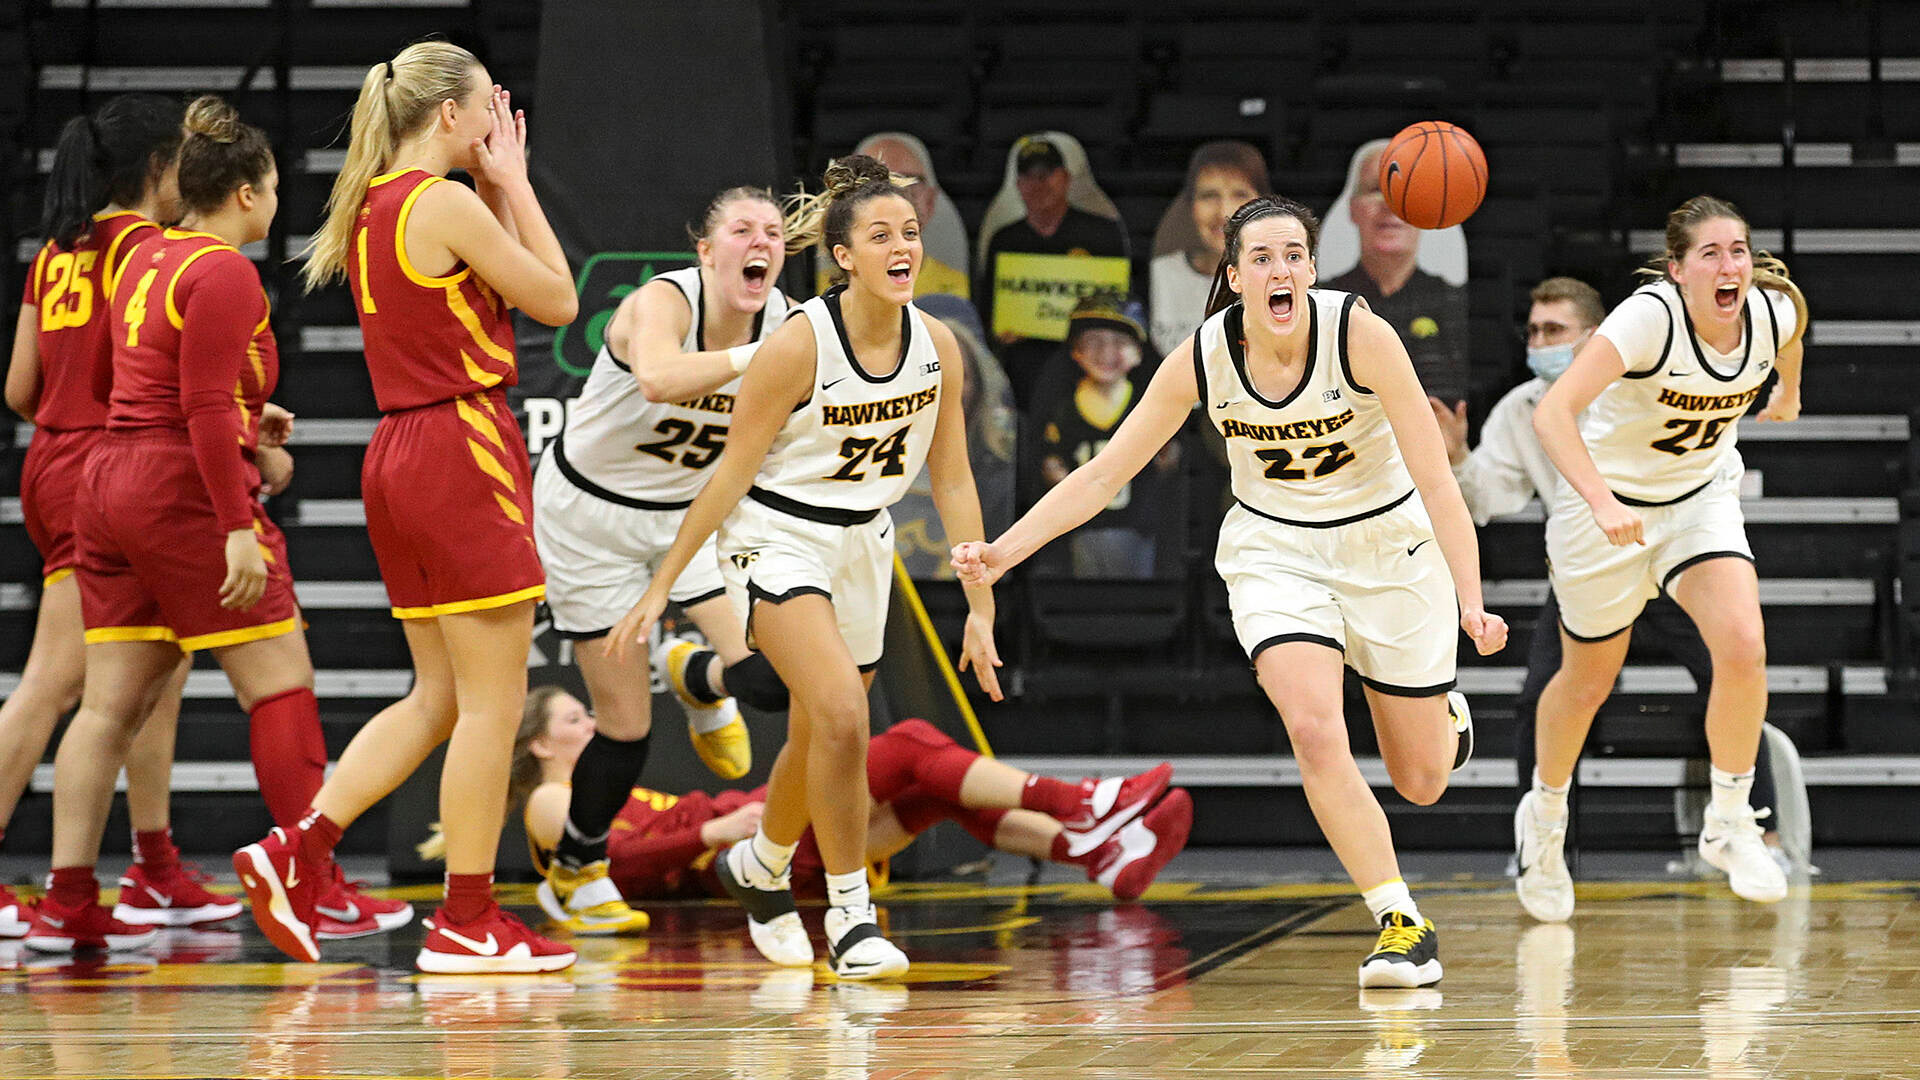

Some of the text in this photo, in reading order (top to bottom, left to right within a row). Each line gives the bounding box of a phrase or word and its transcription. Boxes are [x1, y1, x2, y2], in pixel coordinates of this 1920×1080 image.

[41, 250, 99, 332] 25
[357, 226, 378, 314] 1
[123, 268, 159, 347] 4
[822, 383, 938, 427] HAWKEYES
[1221, 407, 1355, 442] HAWKEYES
[1657, 385, 1762, 412] HAWKEYE
[633, 417, 729, 471] 25
[821, 422, 913, 483] 24
[1253, 440, 1356, 481] 22
